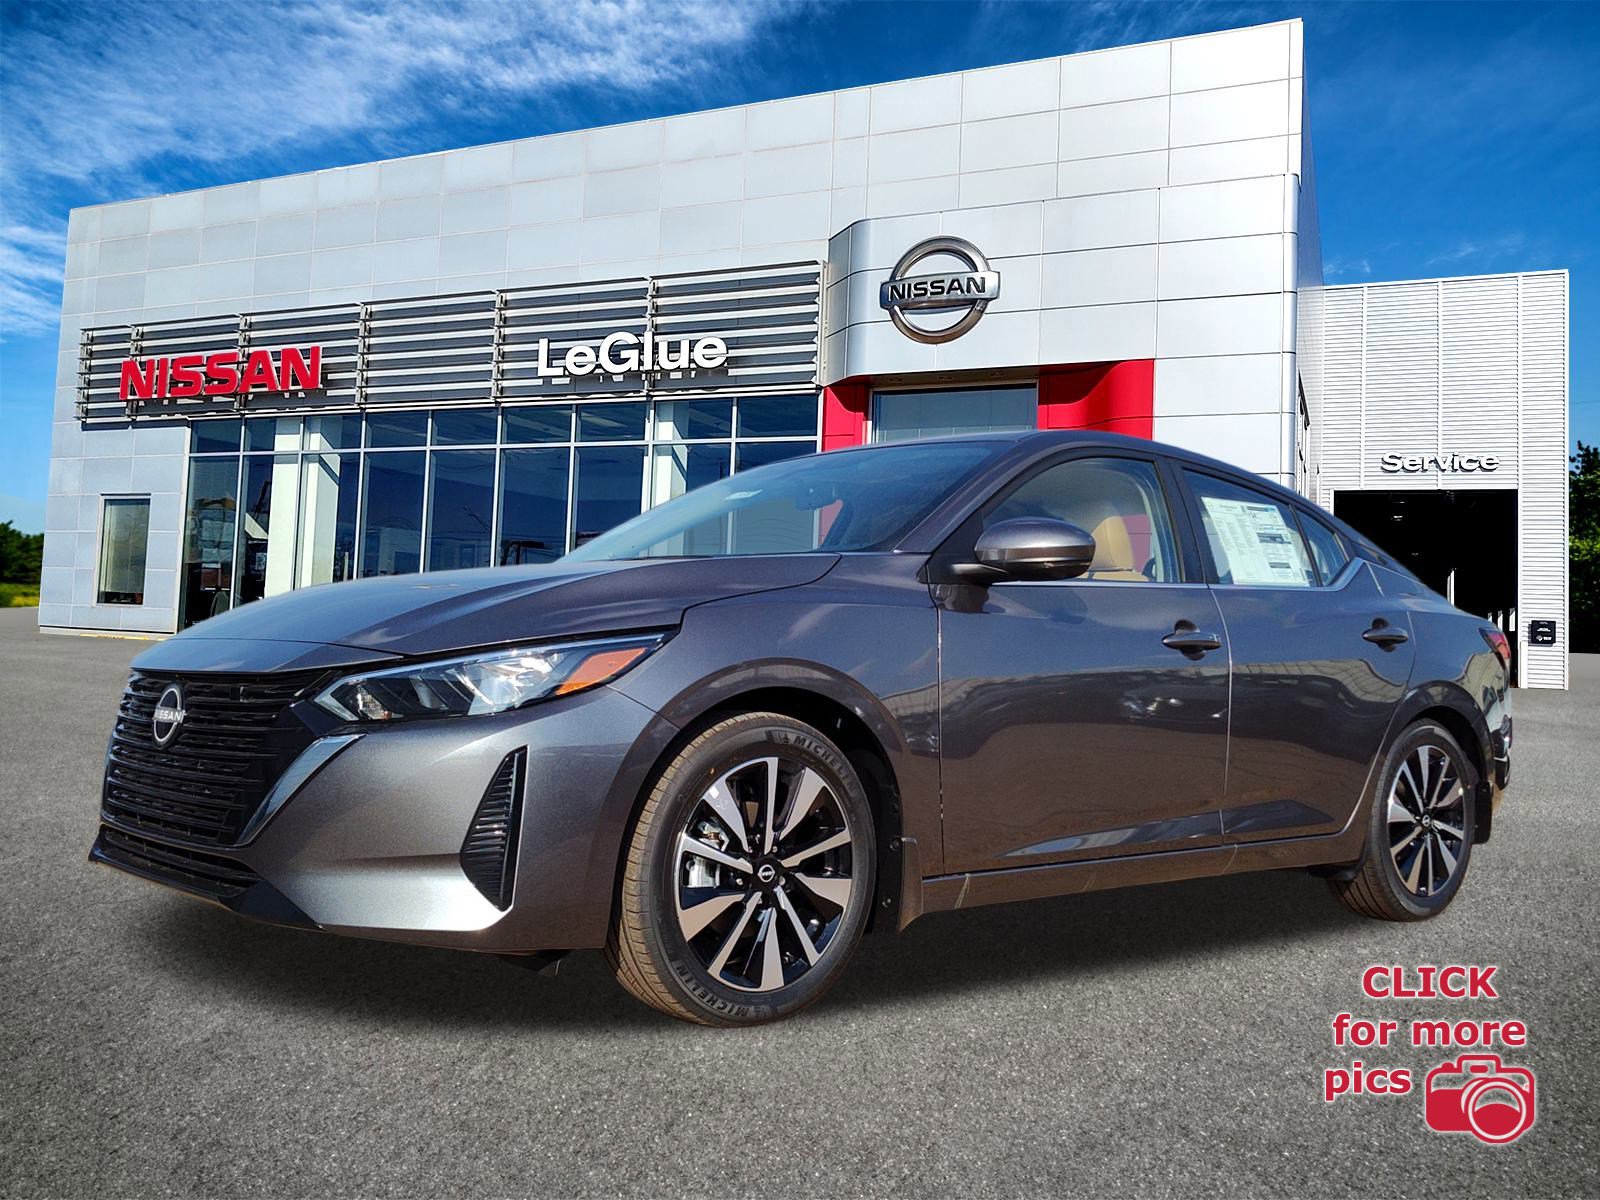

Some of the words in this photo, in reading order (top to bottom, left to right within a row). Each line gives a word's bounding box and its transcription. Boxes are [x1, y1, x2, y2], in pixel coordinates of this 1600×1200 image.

[888, 276, 985, 301] NISSAN
[537, 331, 728, 377] LeGlue
[119, 346, 322, 400] NISSAN
[1381, 450, 1500, 473] Service
[154, 708, 182, 721] SSAN
